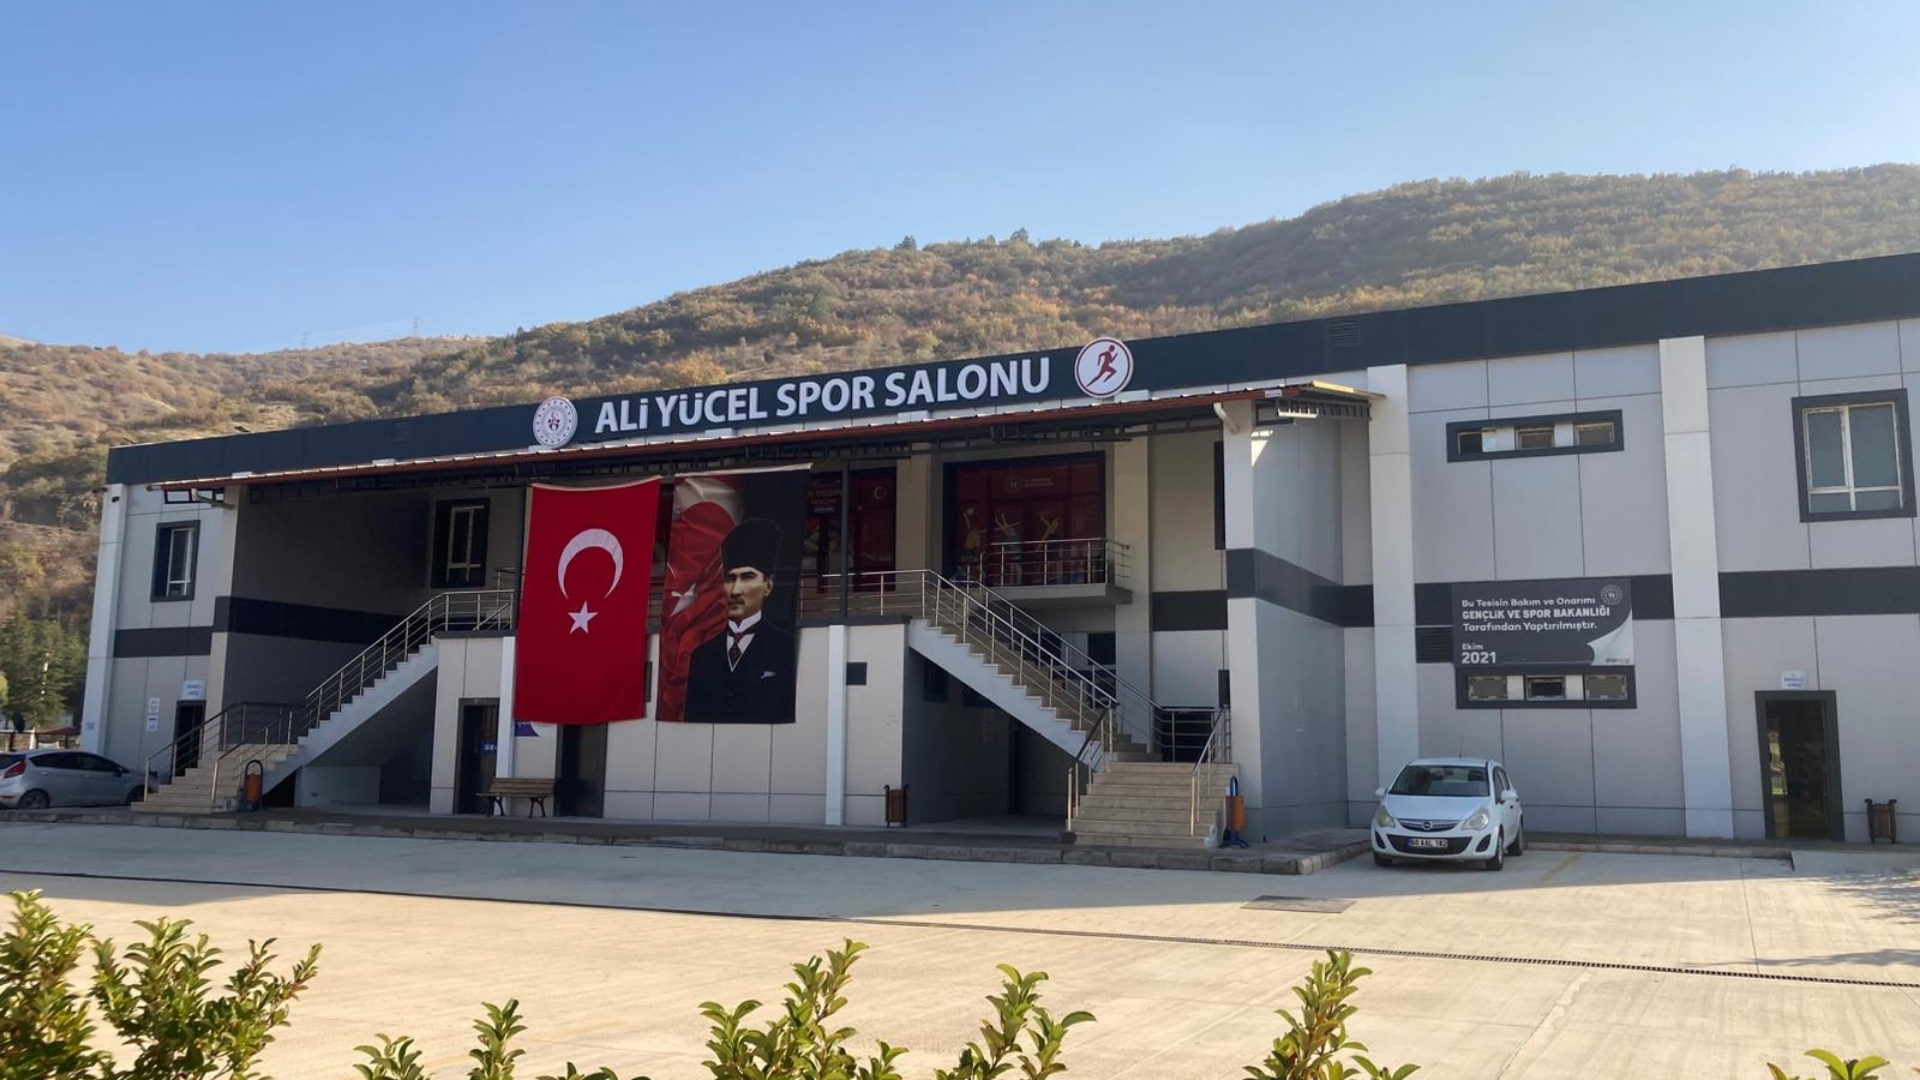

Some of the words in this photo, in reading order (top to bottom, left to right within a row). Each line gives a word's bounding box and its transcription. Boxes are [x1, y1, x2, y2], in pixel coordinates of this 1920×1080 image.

[655, 388, 768, 427] YÜCEL
[776, 375, 875, 417] SPOR
[885, 357, 1049, 407] SALONU
[1462, 600, 1475, 608] Bu
[1476, 599, 1508, 607] Tesisin
[1511, 598, 1541, 606] Bakım
[1556, 597, 1596, 605] Onarımı
[1507, 609, 1520, 618] VE
[1523, 609, 1551, 618] SPOR
[1554, 605, 1610, 618] BAKANLIĞI
[1463, 622, 1521, 631] Tarafından
[1461, 651, 1496, 664] 2021
